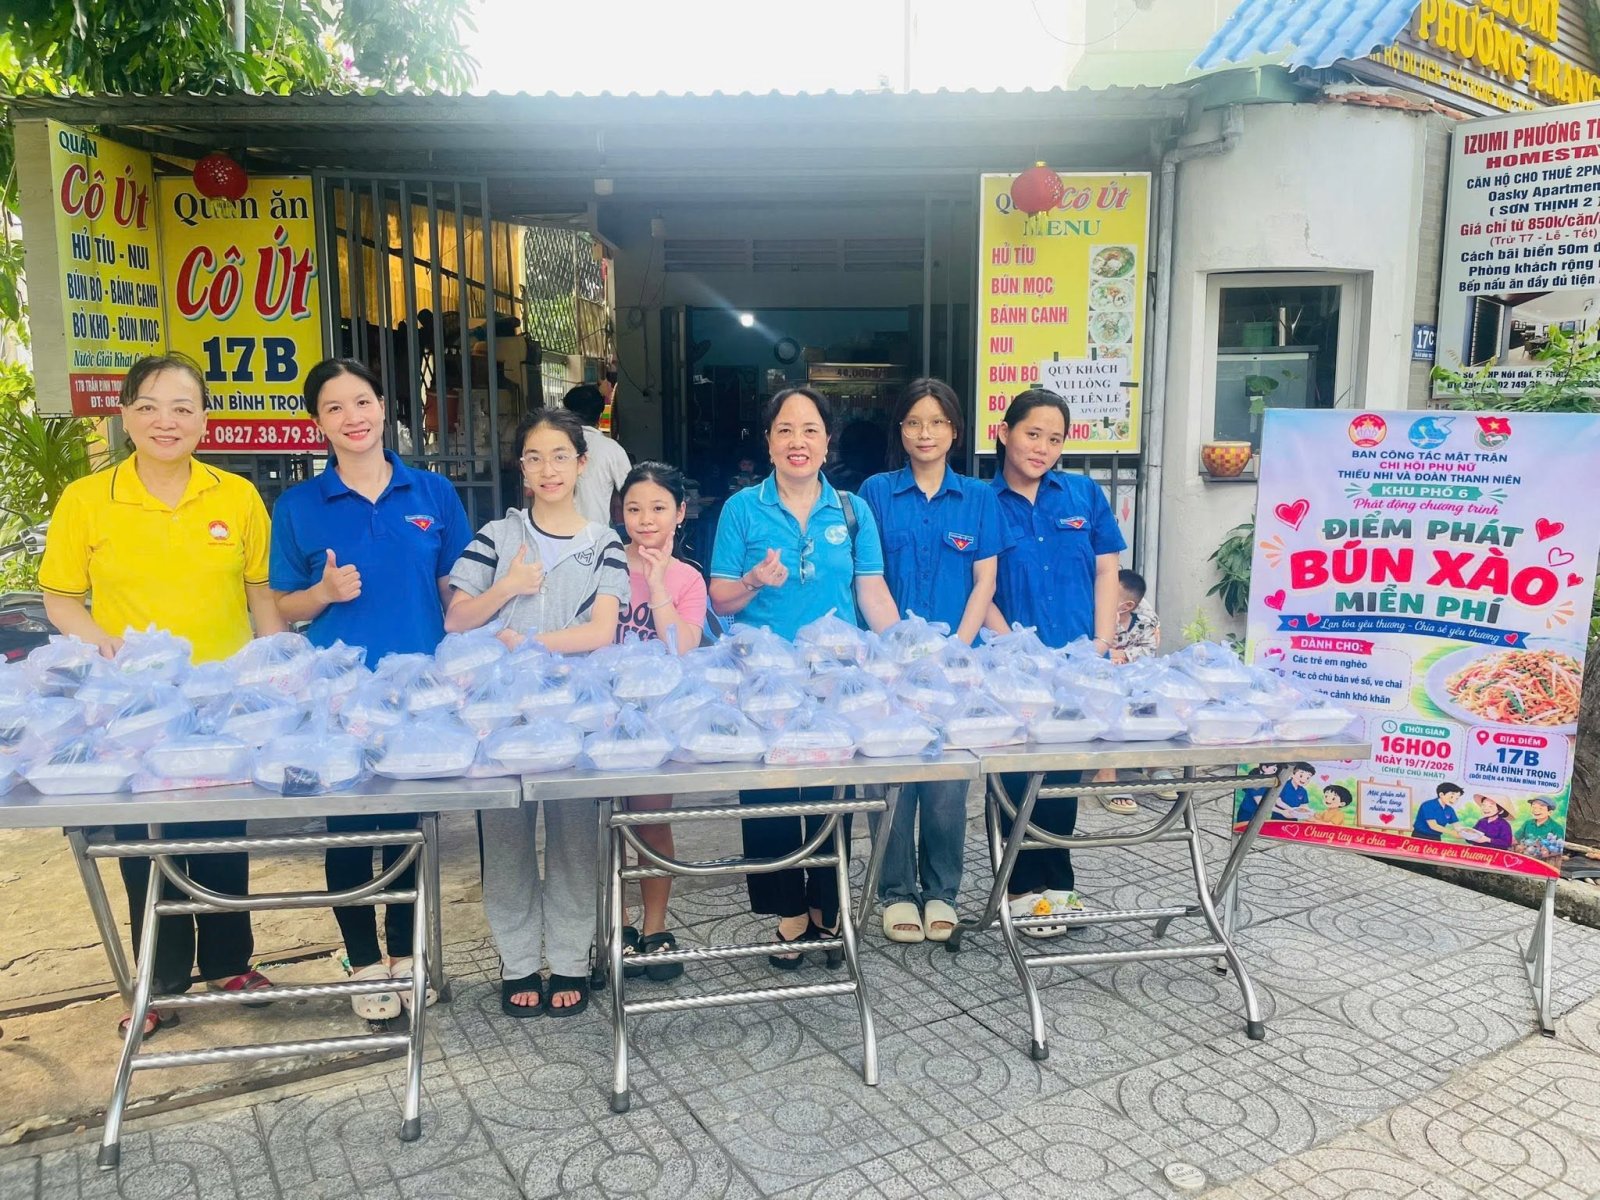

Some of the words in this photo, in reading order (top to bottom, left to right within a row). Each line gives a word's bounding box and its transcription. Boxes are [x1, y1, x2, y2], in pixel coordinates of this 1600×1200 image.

[59, 132, 98, 158] QUÁN
[1464, 131, 1508, 155] IZUMI
[1513, 121, 1581, 149] PHƯƠNG
[1486, 144, 1600, 169] HOMESTA
[1466, 176, 1491, 189] CĂN
[1494, 172, 1510, 187] HỘ
[1514, 171, 1538, 184] CHO
[1542, 165, 1573, 181] THUÊ
[60, 163, 106, 221] Cô
[113, 163, 150, 230] Út
[1057, 186, 1092, 211] Cô
[1096, 180, 1130, 210] Út
[1488, 189, 1529, 201] Oasky
[1533, 182, 1600, 197] Apartmen
[270, 188, 310, 219] ăn
[1500, 203, 1529, 215] SƠN
[1534, 198, 1578, 212] THỊNH
[1583, 197, 1593, 207] 2
[1460, 222, 1482, 236] Giá
[1486, 219, 1507, 233] chỉ
[1511, 219, 1525, 231] từ
[1520, 233, 1534, 243] T7
[72, 226, 91, 261] HỦ
[94, 233, 116, 265] TÍU
[127, 244, 150, 270] NUI
[991, 241, 1011, 265] HỦ
[1013, 243, 1036, 265] TÍU
[1461, 250, 1494, 263] Cách
[1523, 243, 1554, 258] biển
[1558, 243, 1589, 255] 50m
[176, 245, 244, 321] Cô
[254, 224, 318, 321] Út
[1469, 264, 1510, 277] Phòng
[1515, 261, 1557, 274] khách
[1562, 259, 1594, 273] rộng
[67, 268, 88, 301] BÚN
[89, 271, 103, 302] BÒ
[110, 275, 135, 306] BÁNH
[136, 283, 159, 308] CANH
[991, 274, 1019, 295] BÚN
[1023, 276, 1054, 298] MỌC
[1459, 279, 1480, 293] Bếp
[1484, 276, 1505, 291] nấu
[1509, 277, 1523, 289] ăn
[1571, 274, 1595, 287] tiện
[990, 303, 1028, 324] BÁNH
[1031, 306, 1069, 324] CANH
[72, 306, 87, 339] BÒ
[89, 313, 110, 340] KHO
[117, 311, 138, 341] BÚN
[140, 318, 160, 348] MỌC
[989, 336, 1014, 354] NUI
[1416, 329, 1435, 350] 17C
[74, 350, 95, 367] Nước
[96, 350, 113, 367] Giải
[989, 363, 1017, 383] BÚN
[1020, 361, 1039, 382] BÒ
[1048, 363, 1071, 376] QUÝ
[1076, 362, 1117, 374] KHÁCH
[1055, 380, 1075, 389] VUI
[1079, 377, 1111, 389] LÒNG
[229, 391, 264, 410] BÌNH
[988, 390, 1006, 412] BÒ
[1081, 392, 1103, 403] LÊN
[1352, 450, 1377, 459] BAN
[1380, 449, 1414, 460] CÔNG
[1418, 450, 1441, 460] TÁC
[1475, 453, 1508, 464] TRẬN
[1338, 469, 1370, 479] THIẾU
[1396, 472, 1412, 481] VÀ
[1415, 472, 1447, 482] ĐOÀN
[1451, 474, 1490, 484] THANH
[1493, 475, 1521, 485] NIÊN
[1379, 462, 1400, 470] CHI
[1403, 462, 1425, 473] HỘI
[1428, 464, 1454, 473] PHỤ
[1457, 463, 1476, 472] NỮ
[1381, 486, 1415, 496] KHU
[1420, 484, 1454, 497] PHỐ
[1458, 488, 1469, 498] 6
[1353, 498, 1384, 509] Phát
[1386, 500, 1417, 513] động
[1419, 501, 1464, 516] chương
[1468, 503, 1499, 515] trình
[1321, 510, 1413, 541] ĐIỂM
[1426, 519, 1525, 548] PHÁT
[1290, 539, 1414, 590] BÚN
[1426, 546, 1559, 607] XÀO
[1335, 584, 1425, 614] MIỄN
[1436, 597, 1506, 624] PHÍ
[1320, 618, 1340, 629] Lan
[1342, 619, 1356, 629] tỏa
[1357, 620, 1374, 632] yêu
[1376, 619, 1406, 632] thương
[1414, 621, 1435, 632] Chia
[1437, 625, 1448, 634] sẻ
[1448, 629, 1466, 638] yêu
[1468, 628, 1500, 644] thương
[1301, 638, 1333, 649] DÀNH
[1336, 642, 1364, 652] CHO:
[1292, 655, 1308, 664] Các
[1310, 656, 1323, 665] trẻ
[1340, 660, 1368, 669] nghèo
[1307, 672, 1317, 680] cô
[1318, 673, 1333, 681] chú
[1334, 674, 1349, 683] bán
[1350, 675, 1360, 684] vé
[1361, 676, 1373, 686] số,
[1385, 680, 1402, 688] chai
[1330, 690, 1351, 700] cảnh
[1352, 692, 1368, 701] khó
[1370, 694, 1391, 704] khăn
[1404, 725, 1424, 734] THỜI
[1425, 728, 1446, 736] GIAN
[1380, 736, 1452, 759] 16H00
[1500, 736, 1516, 746] ĐỊA
[1518, 736, 1542, 747] ĐIỂM
[1375, 754, 1402, 765] NGÀY
[1404, 758, 1455, 771] 19/7/2026
[1496, 747, 1540, 767] 17B
[1381, 766, 1405, 775] (CHIỀU
[1407, 768, 1421, 776] CHỦ
[1423, 771, 1446, 780] NHẬT)
[1475, 762, 1499, 773] TRẦN
[1501, 766, 1524, 776] BÌNH
[1526, 768, 1557, 779] TRỌNG
[1522, 778, 1537, 786] BÌNH
[1304, 825, 1336, 845] Chung
[1337, 831, 1352, 845] tay
[1355, 833, 1365, 844] sẻ
[1366, 837, 1387, 847] chia
[1396, 838, 1420, 852] Lan
[1422, 845, 1438, 855] tỏa
[1440, 848, 1458, 859] yêu
[1460, 850, 1500, 864] thương!
